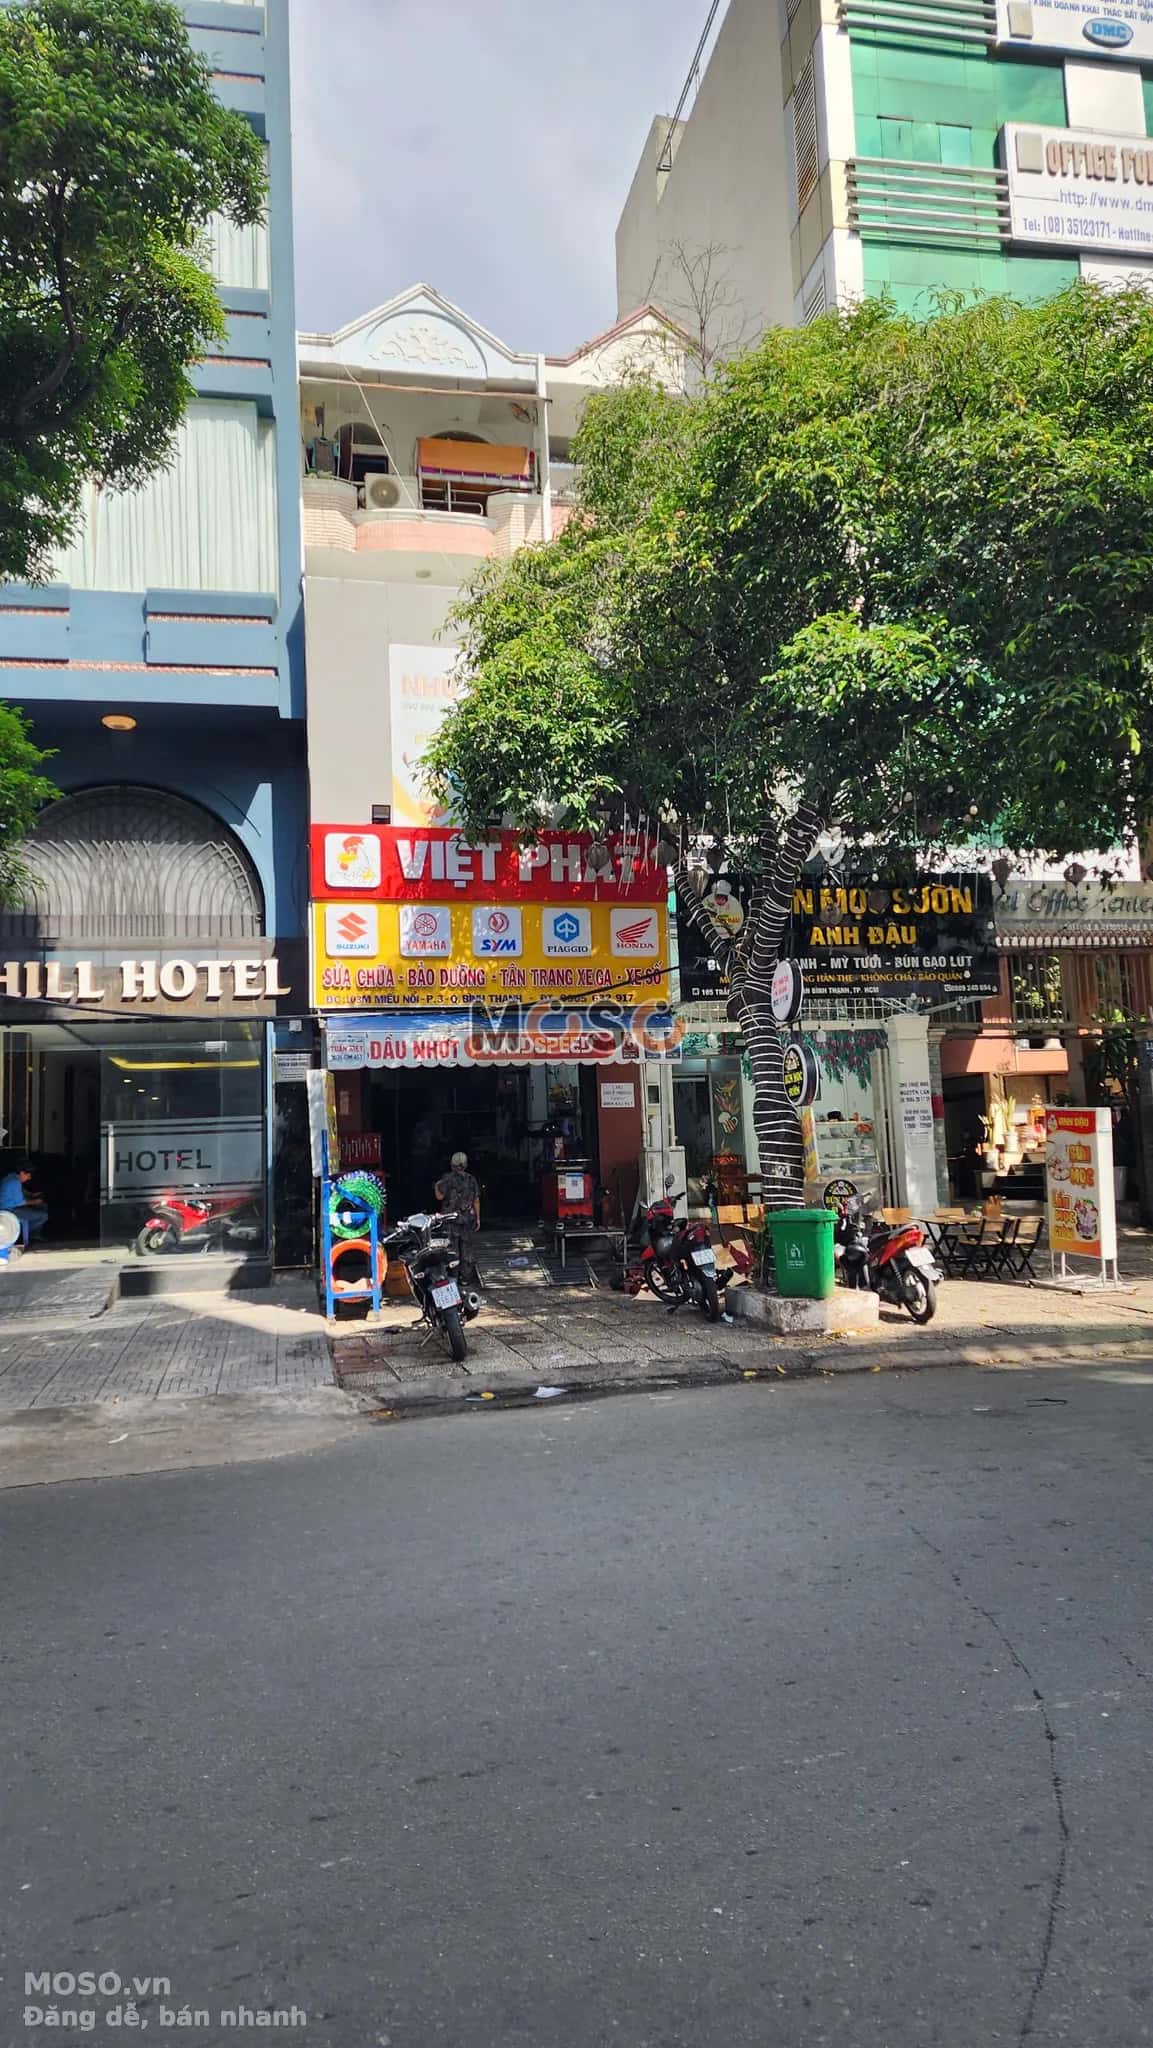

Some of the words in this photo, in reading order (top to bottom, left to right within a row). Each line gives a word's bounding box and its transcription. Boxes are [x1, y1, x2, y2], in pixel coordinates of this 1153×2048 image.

[1091, 22, 1128, 39] DMC
[1046, 139, 1117, 181] OFFICE
[1022, 217, 1041, 232] Tel:
[1043, 215, 1065, 236] (08)
[1067, 217, 1112, 238] 35123171
[397, 833, 501, 888] VIỆT
[406, 940, 447, 951] YAMAHA
[481, 939, 517, 952] SYM
[810, 926, 860, 946] ANH
[867, 922, 918, 949] ĐẬU
[547, 945, 589, 953] PIAGGIO
[894, 954, 920, 969] BÚN
[922, 956, 947, 970] GẠO
[121, 959, 291, 999] HOTEL
[323, 961, 351, 988] SỬA
[357, 964, 395, 988] CHỮA
[407, 961, 435, 988] BẢO
[440, 963, 486, 988] DƯỠNG
[500, 962, 527, 987] TÂN
[531, 967, 575, 987] TRANG
[615, 993, 634, 1003] 917
[370, 1034, 407, 1060] DẦU
[413, 1035, 460, 1060] NHỚT
[115, 1149, 213, 1171] HOTEL
